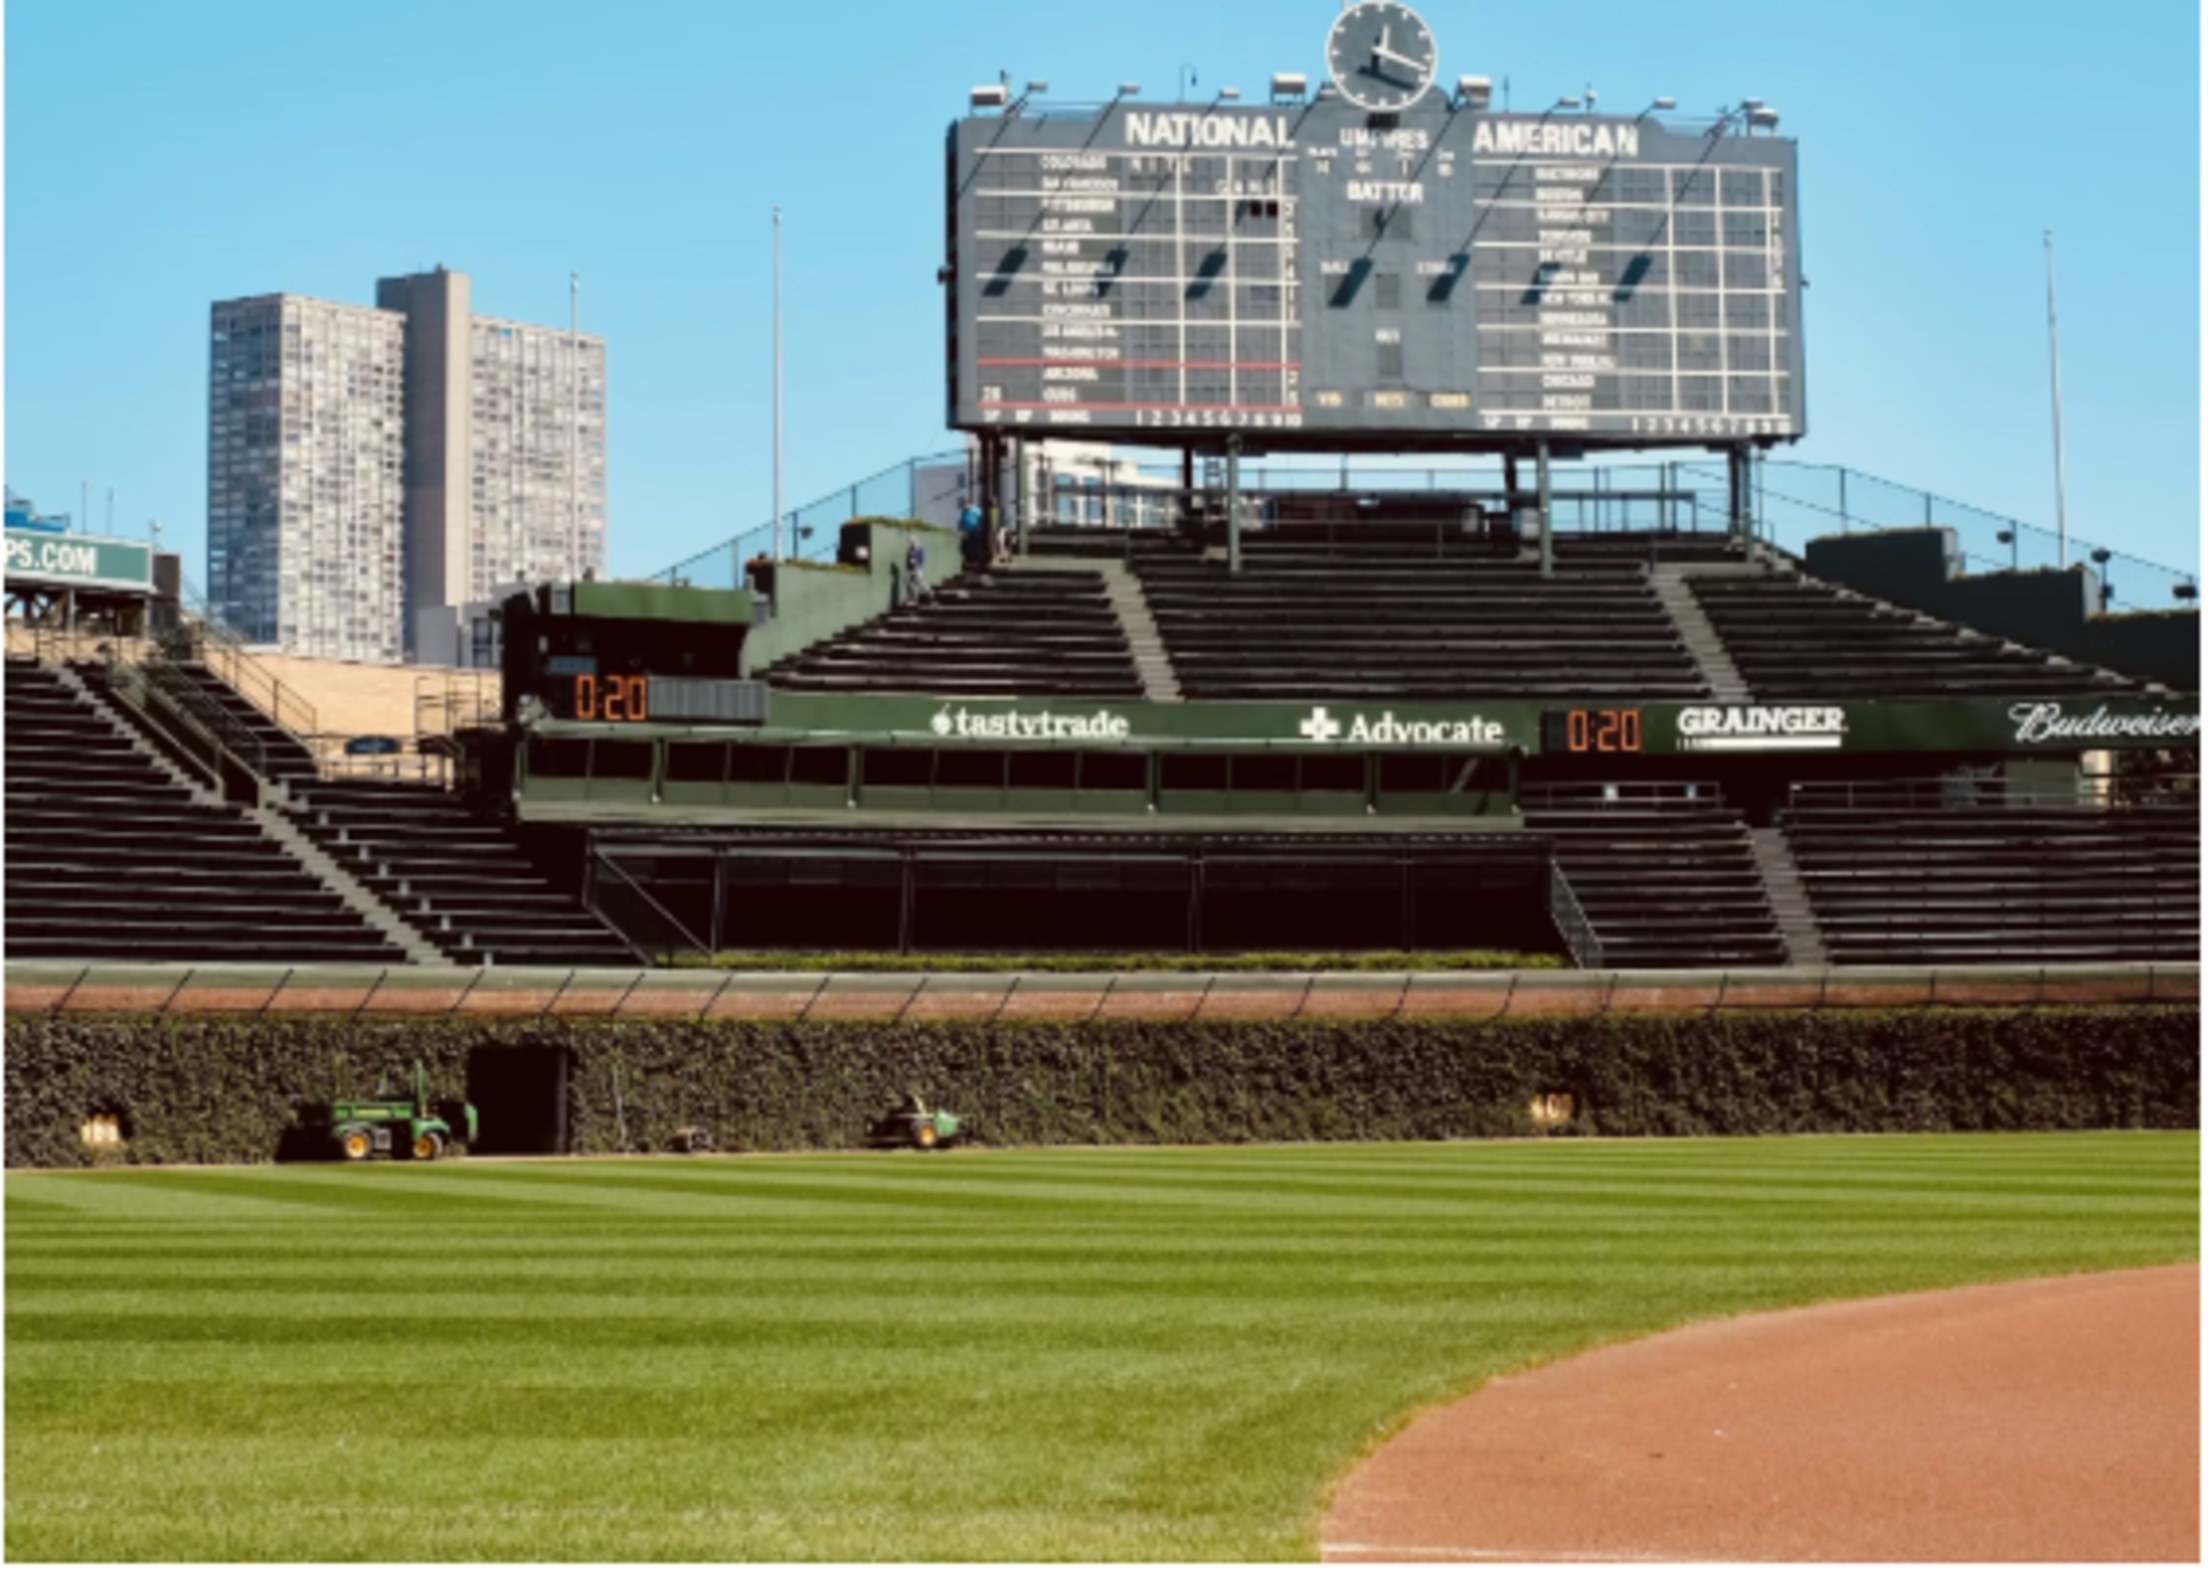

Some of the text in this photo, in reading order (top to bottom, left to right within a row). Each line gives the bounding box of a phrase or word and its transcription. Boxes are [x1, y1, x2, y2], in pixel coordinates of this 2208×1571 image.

[1125, 112, 1296, 148] NATIONAL
[1472, 121, 1638, 156] AMERICAN
[1347, 181, 1423, 201] BATTER
[576, 674, 646, 720] 0:20
[955, 707, 1130, 739] tastytrade
[1349, 711, 1504, 742] Advocate
[1568, 709, 1641, 751] 0:20
[1677, 707, 1845, 735] GRAINGER
